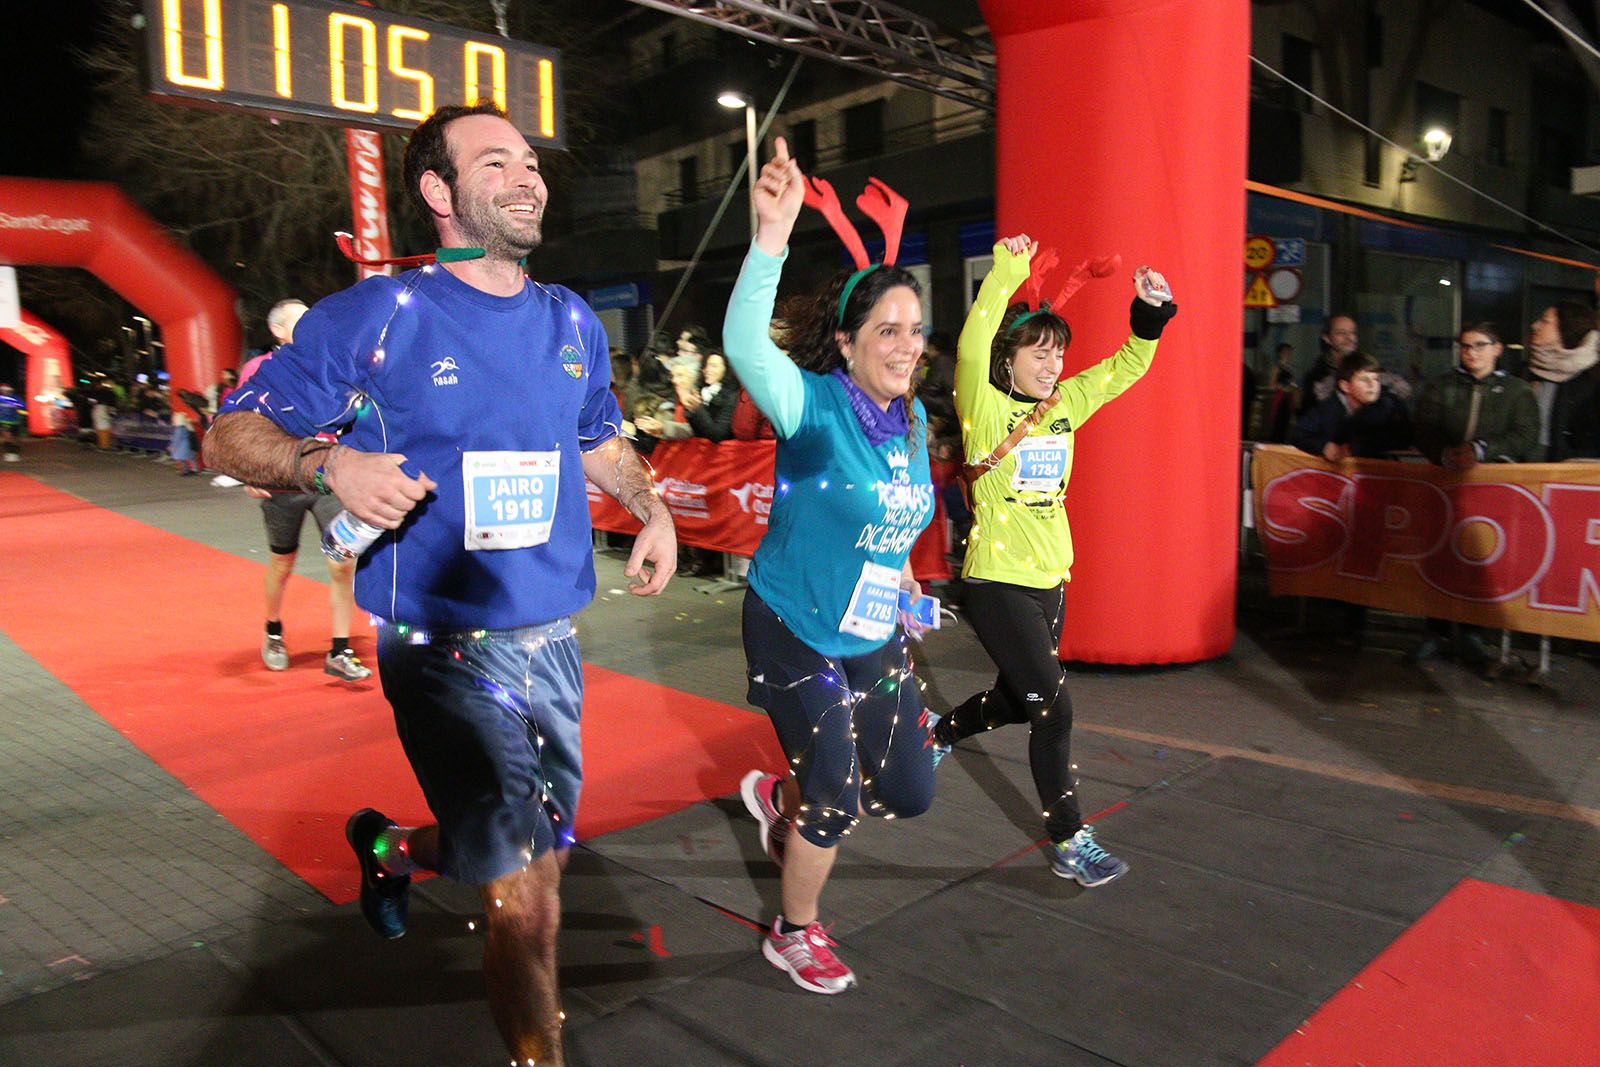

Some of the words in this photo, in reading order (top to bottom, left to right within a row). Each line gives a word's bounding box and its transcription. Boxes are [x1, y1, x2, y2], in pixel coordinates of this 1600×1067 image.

[1027, 450, 1062, 462] ALICIA
[1030, 463, 1059, 476] 1784
[488, 477, 544, 501] JAIRO
[492, 498, 543, 521] 1918
